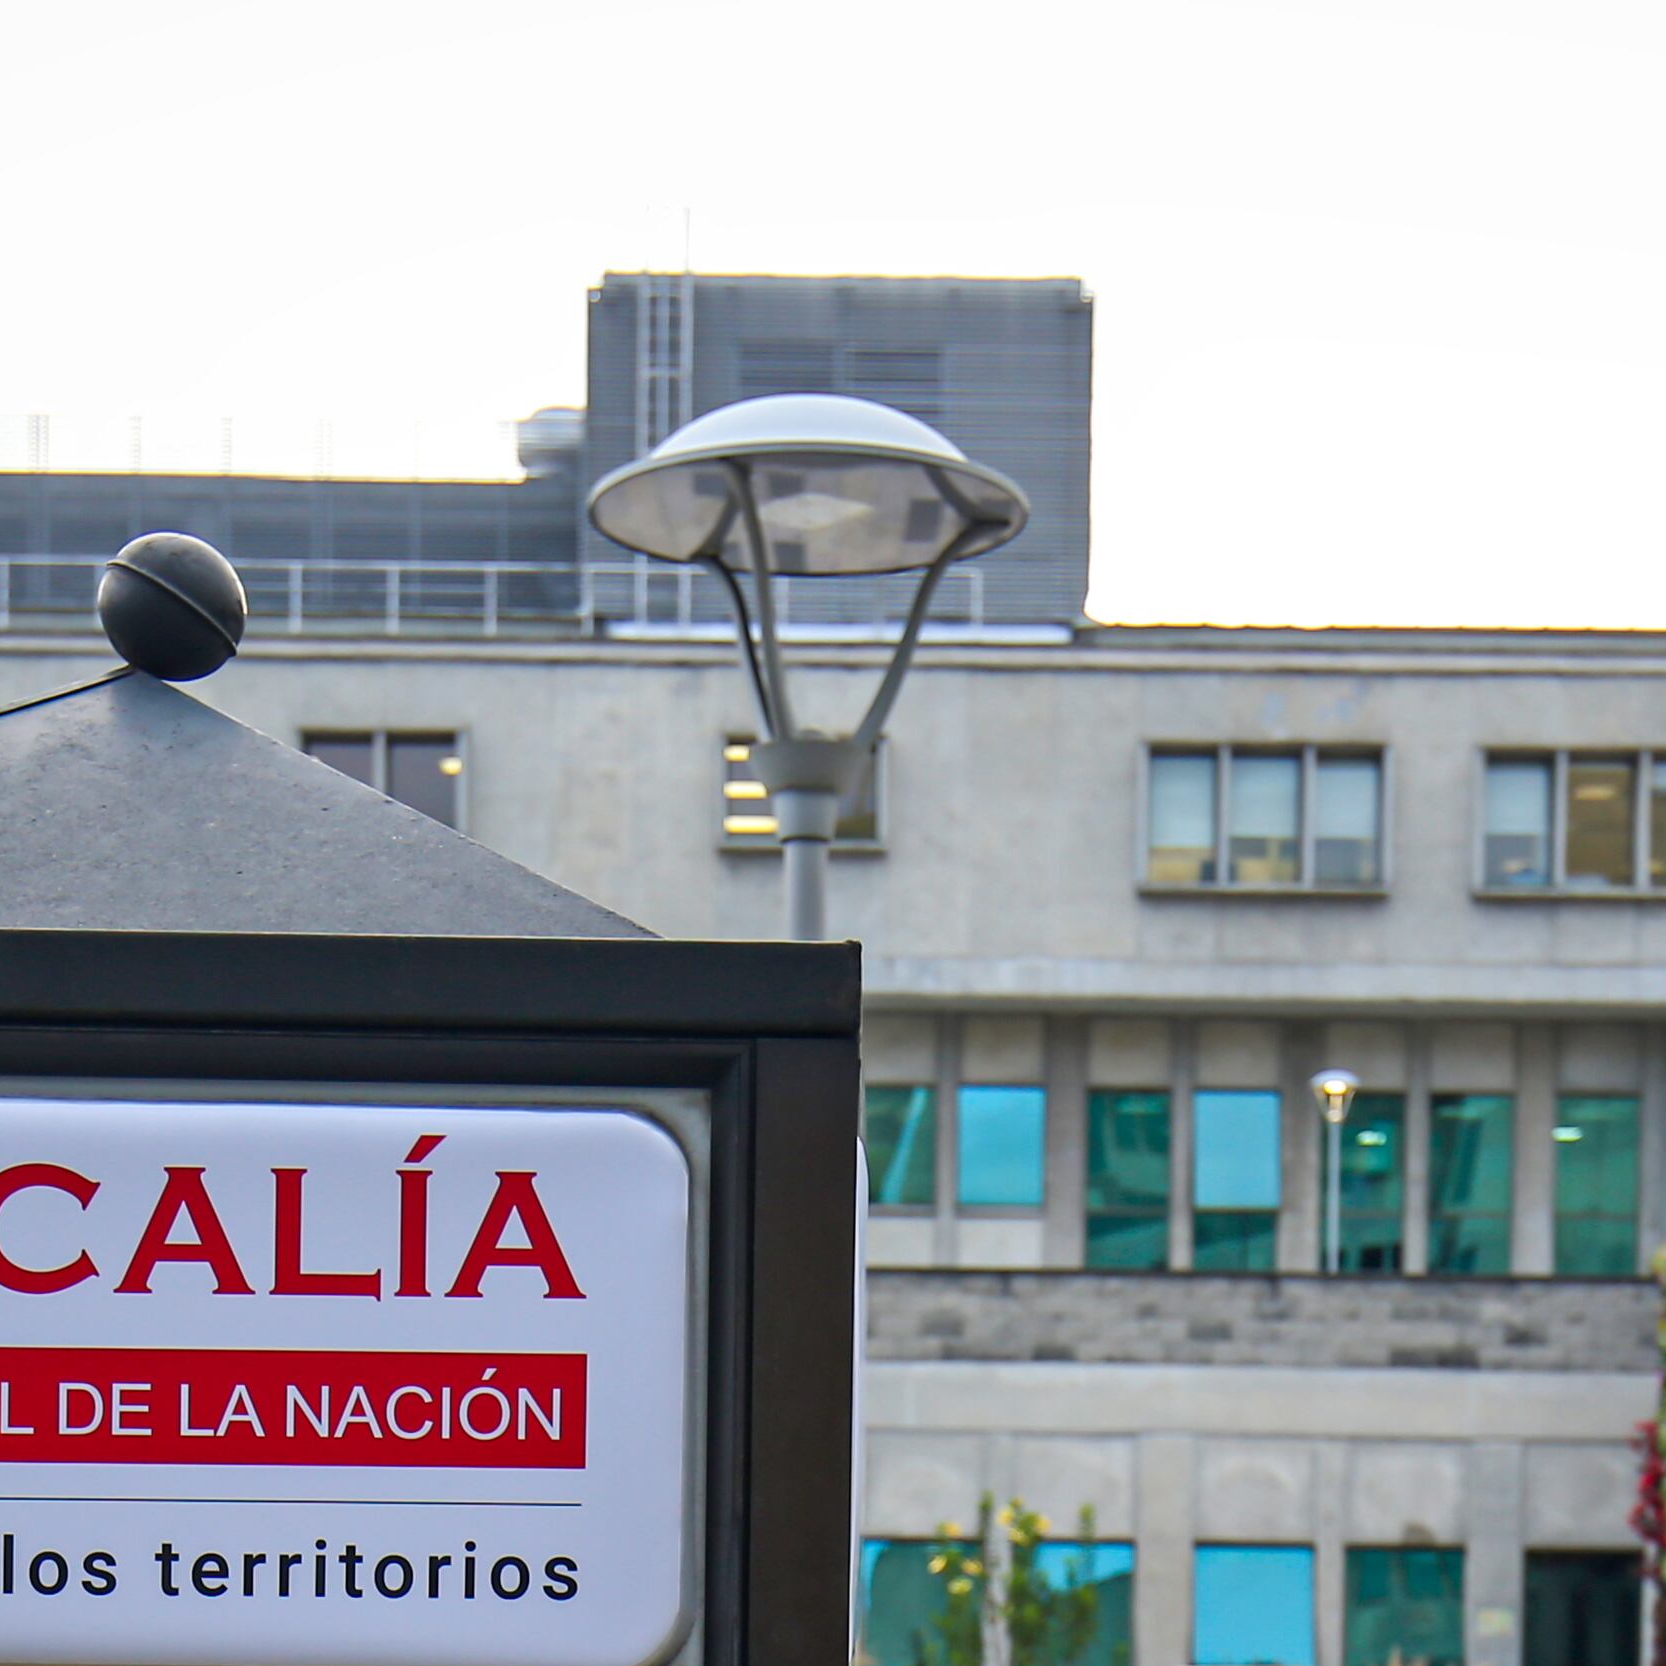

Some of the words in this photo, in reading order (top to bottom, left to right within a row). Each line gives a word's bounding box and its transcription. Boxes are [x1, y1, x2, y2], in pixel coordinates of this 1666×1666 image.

[57, 1380, 153, 1438] DE
[179, 1382, 266, 1439] LA
[285, 1366, 563, 1443] NACIÓN
[2, 1533, 118, 1597] los
[154, 1539, 580, 1603] territorios
